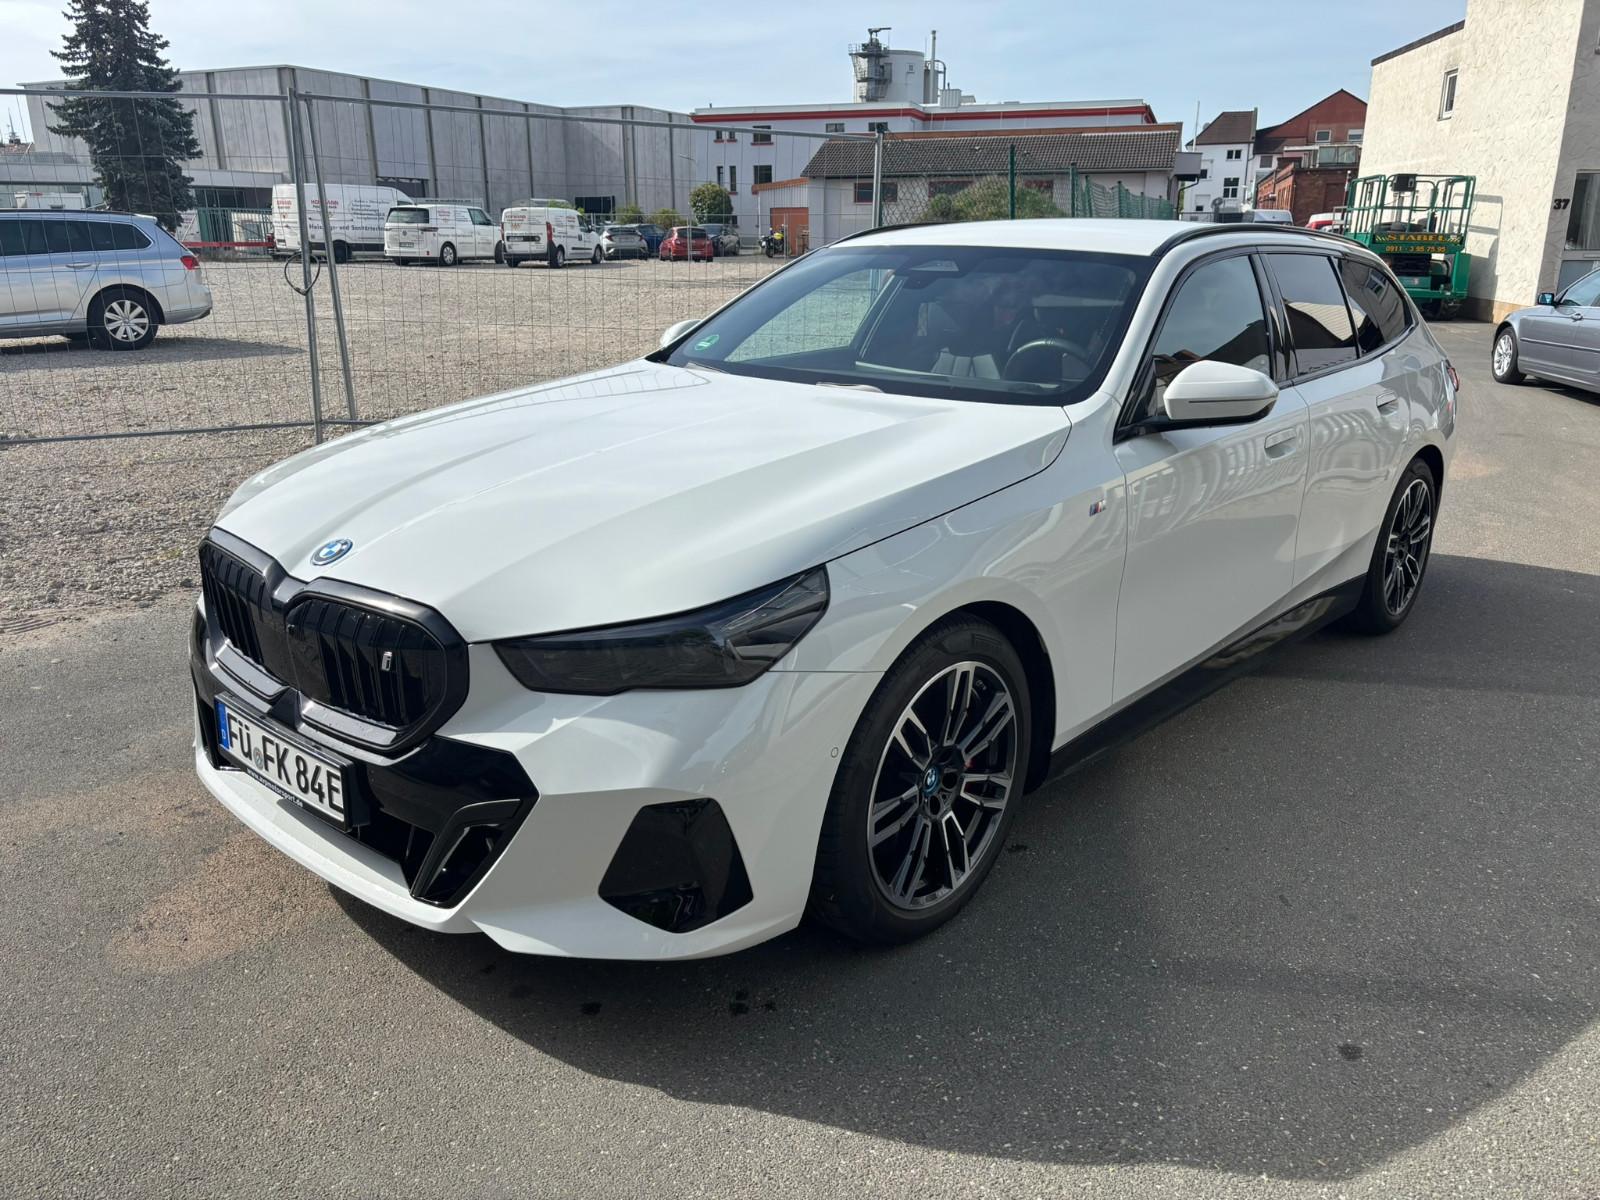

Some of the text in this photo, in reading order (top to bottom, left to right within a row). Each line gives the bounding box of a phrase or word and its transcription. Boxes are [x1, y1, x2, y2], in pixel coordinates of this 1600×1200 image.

[1553, 198, 1570, 210] 37
[227, 712, 344, 814] FÜ FK 84E
